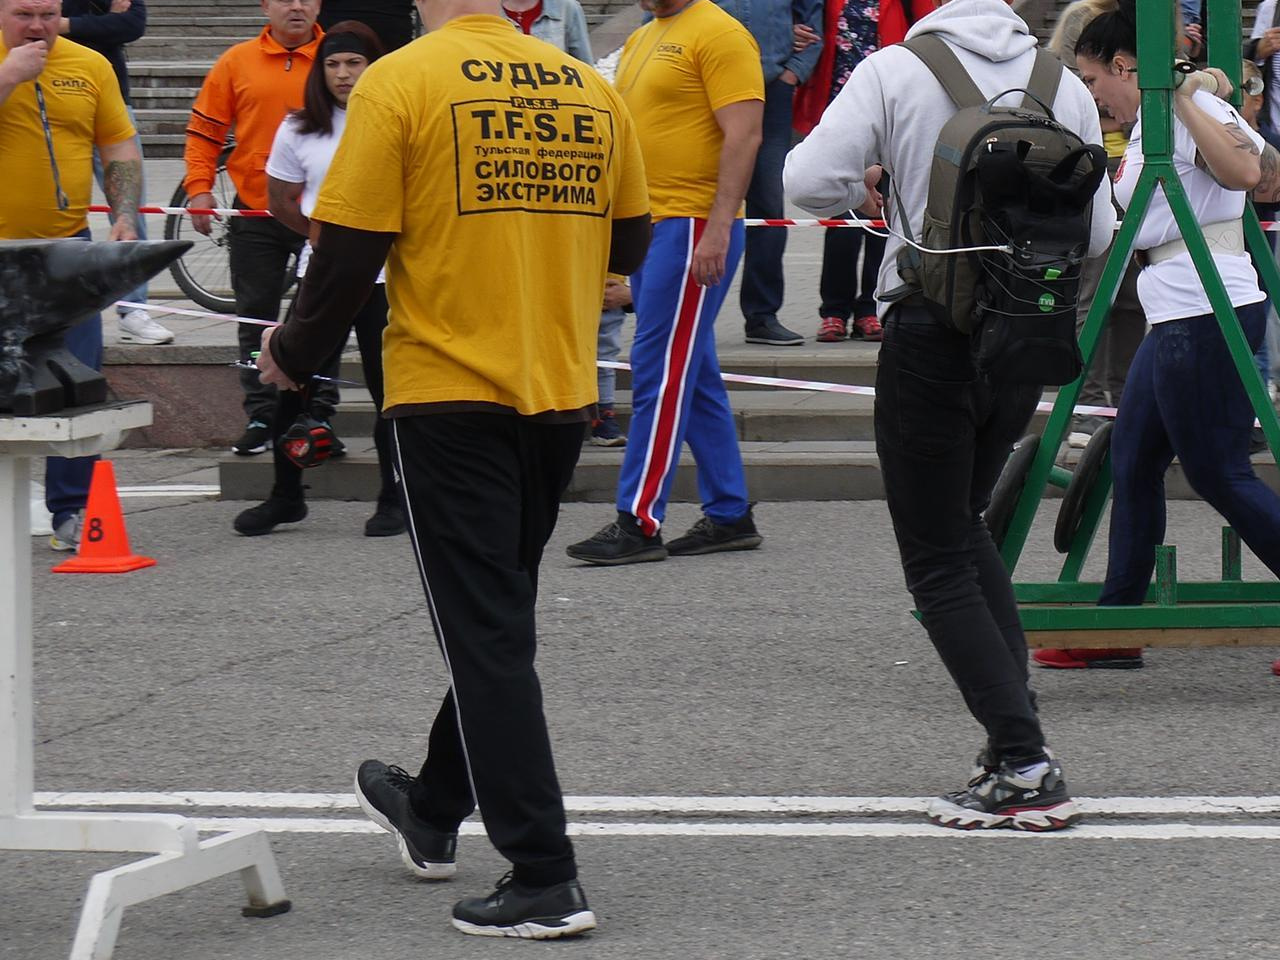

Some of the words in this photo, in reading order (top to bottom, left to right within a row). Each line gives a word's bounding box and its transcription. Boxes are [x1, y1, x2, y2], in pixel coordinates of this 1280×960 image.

[461, 59, 584, 90] СУДЬЯ
[471, 109, 603, 145] T.F.S.E.
[474, 145, 530, 156] Тульская
[537, 145, 605, 161] федерация
[475, 160, 602, 183] СИЛОВОГО
[476, 182, 596, 206] ЭКСТРИМА
[88, 518, 104, 542] 8
